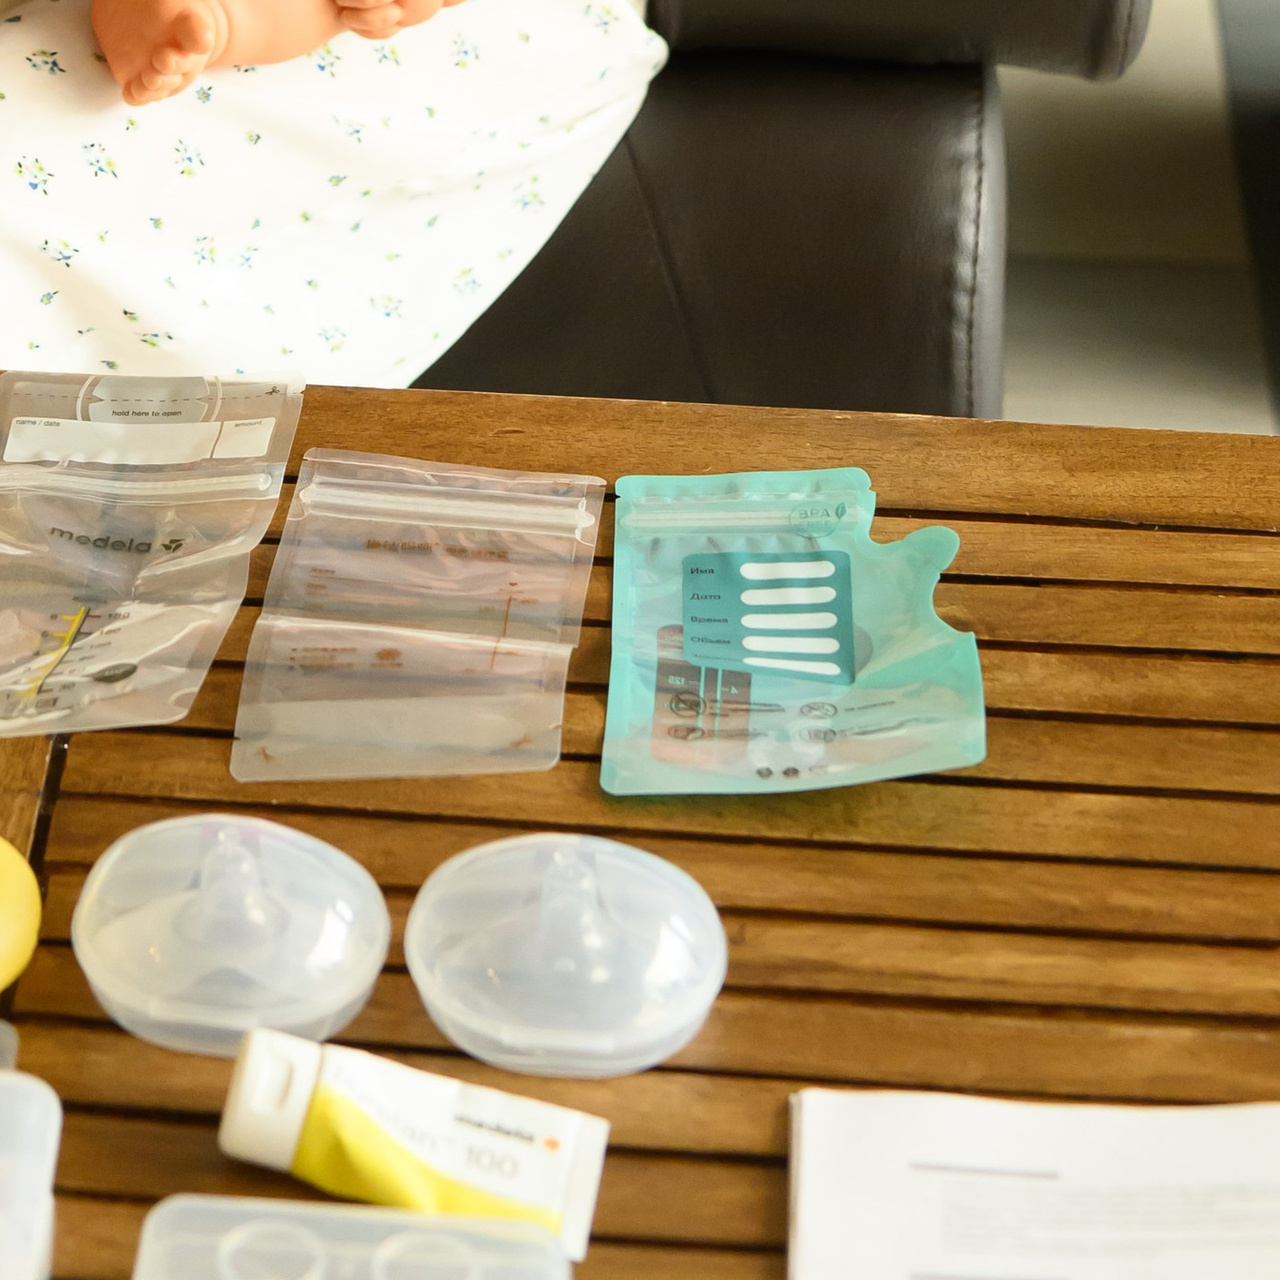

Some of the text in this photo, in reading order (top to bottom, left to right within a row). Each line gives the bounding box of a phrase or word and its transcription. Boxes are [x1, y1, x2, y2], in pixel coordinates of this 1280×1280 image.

[111, 409, 130, 417] hold
[161, 410, 182, 418] open
[234, 420, 263, 428] amount
[798, 507, 832, 520] BPA
[50, 526, 153, 554] medela
[690, 566, 715, 575] Имя
[689, 592, 721, 602] Дата
[690, 616, 729, 625] Время
[465, 1144, 518, 1179] 100
